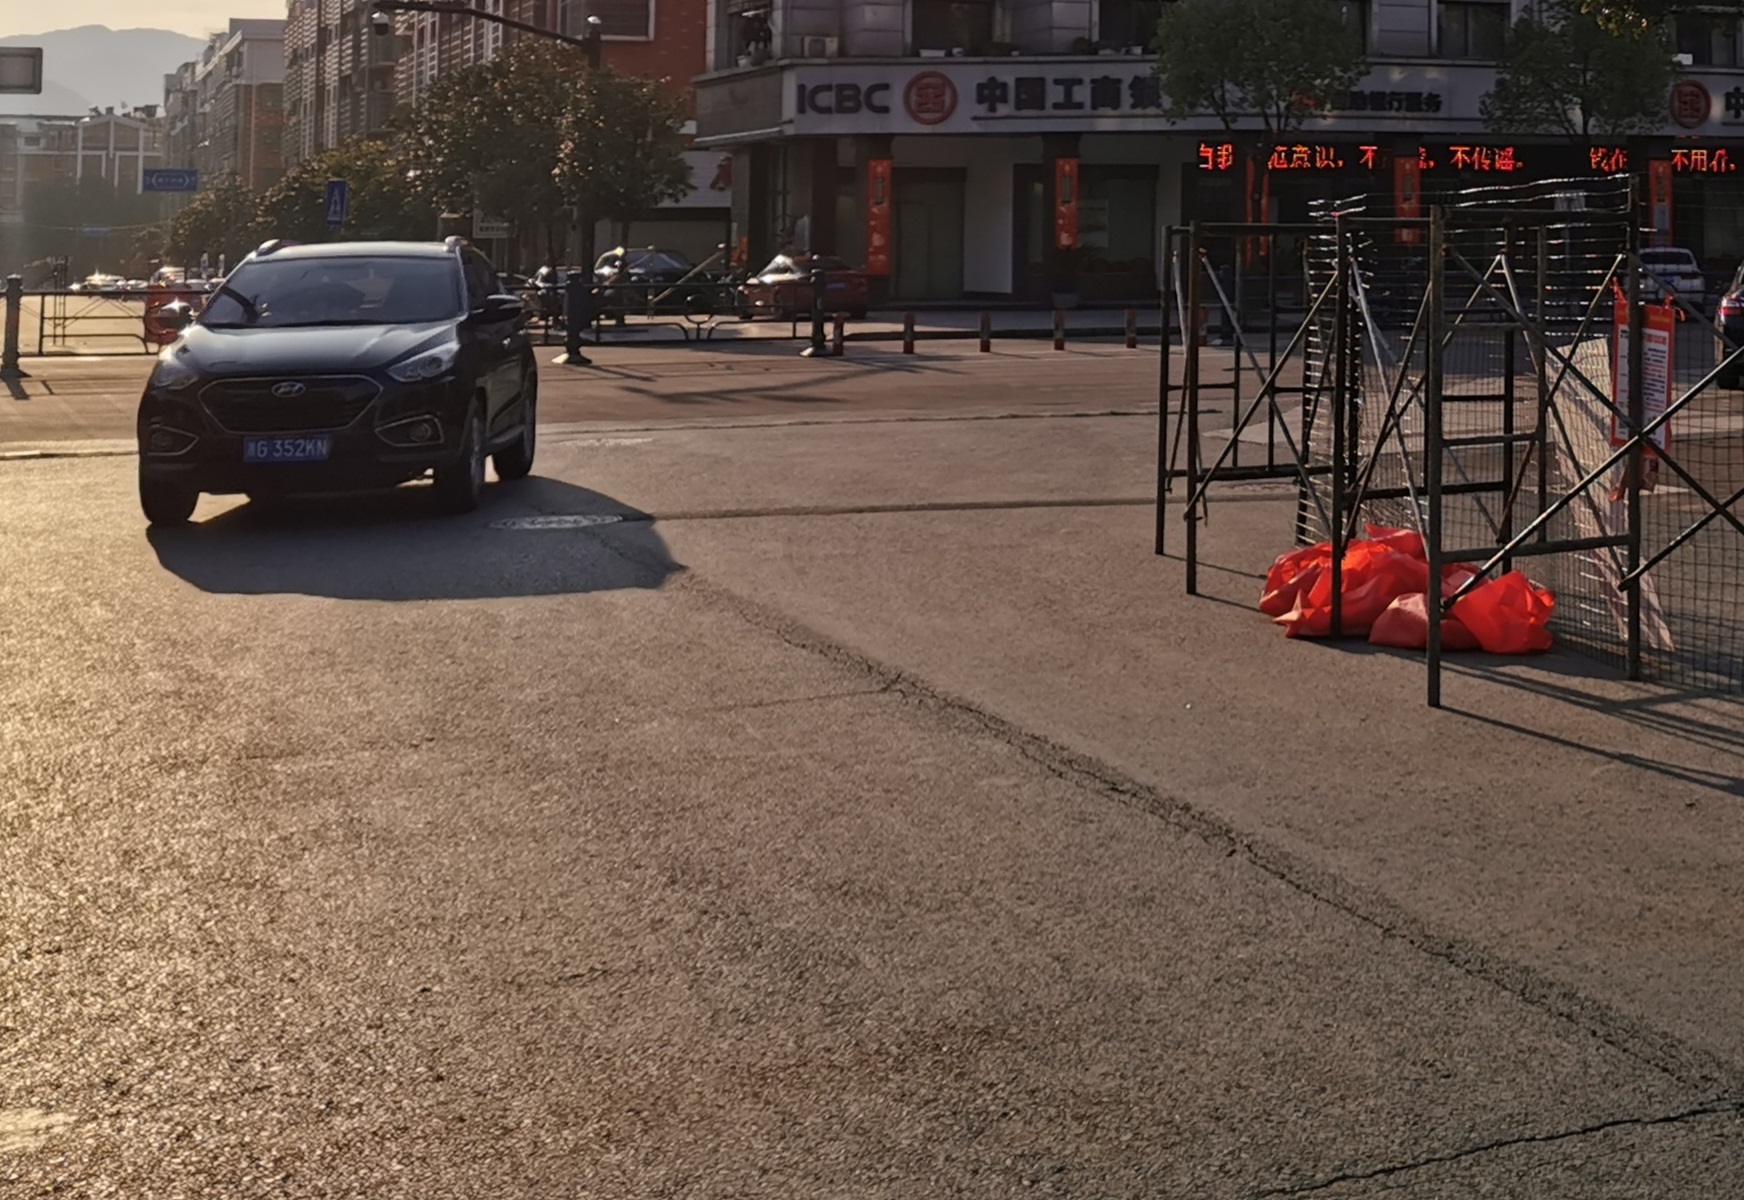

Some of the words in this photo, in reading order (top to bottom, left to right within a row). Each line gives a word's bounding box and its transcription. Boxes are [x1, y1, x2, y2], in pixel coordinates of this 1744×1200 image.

[797, 83, 890, 115] ICBC
[1332, 90, 1443, 113] 助银行服务
